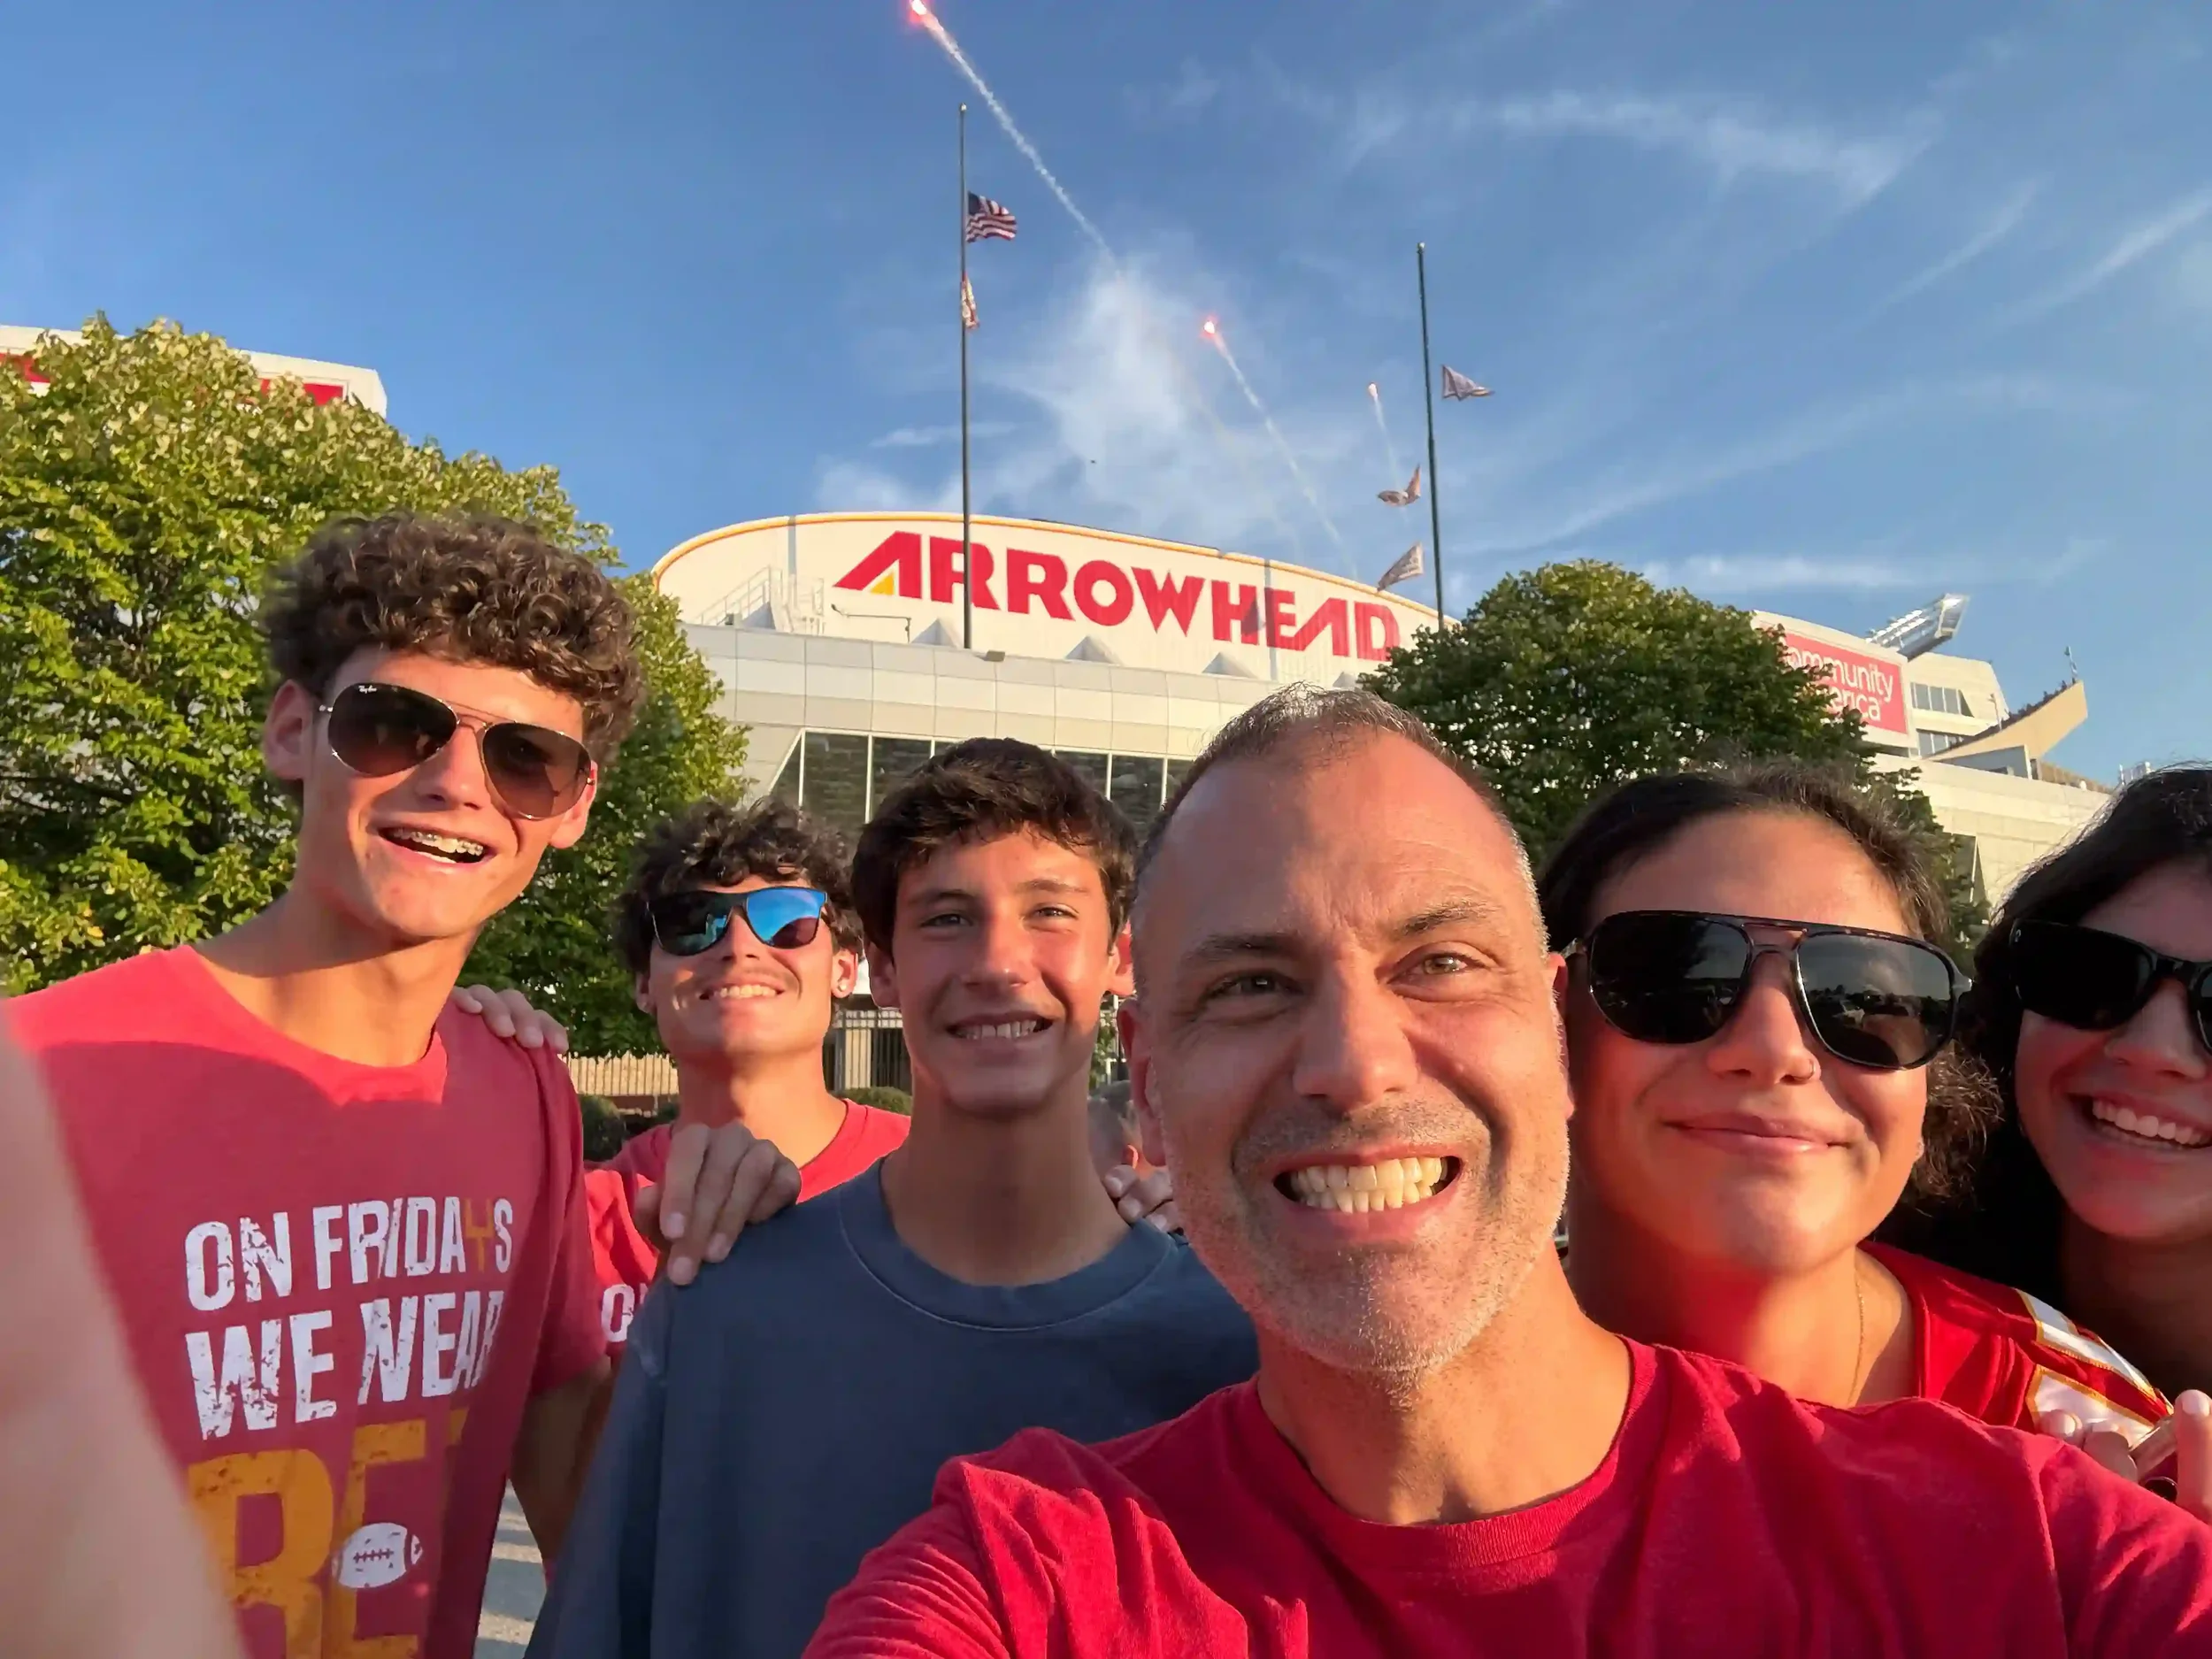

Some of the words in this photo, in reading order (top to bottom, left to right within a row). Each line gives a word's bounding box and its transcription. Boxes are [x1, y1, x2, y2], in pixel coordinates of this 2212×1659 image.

[834, 530, 1401, 662] ARROWHEAD
[1779, 637, 1893, 703] ommunity
[184, 1211, 292, 1311] ON
[312, 1196, 513, 1290] FRIDAYS
[601, 1283, 649, 1342] O
[185, 1310, 337, 1440] WE
[188, 1407, 470, 1659] RE
